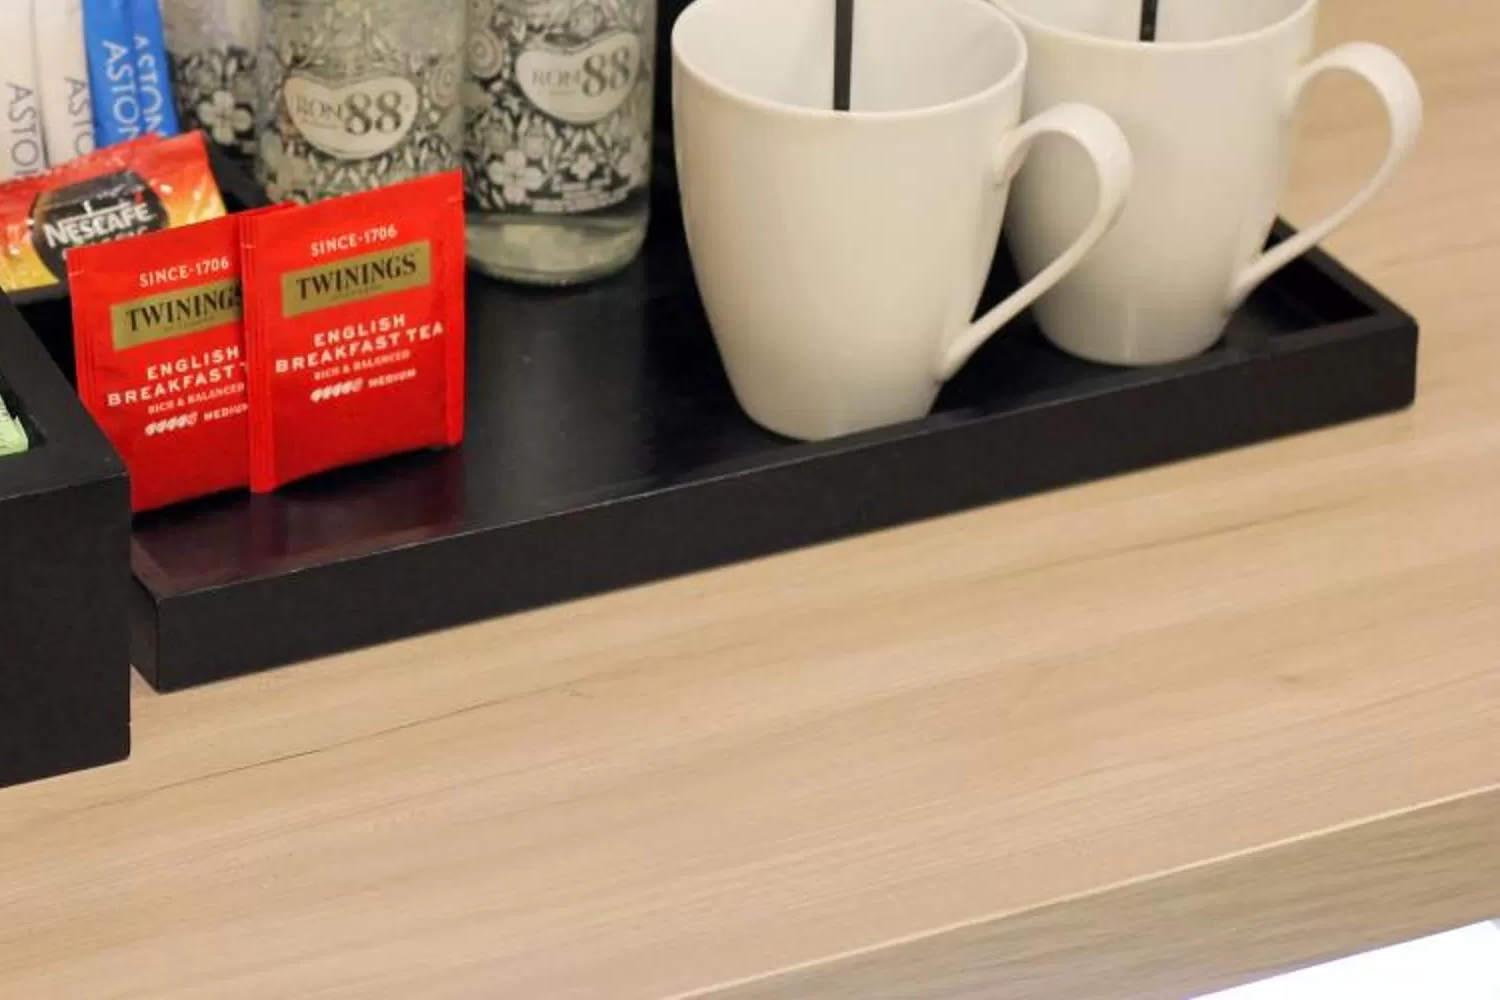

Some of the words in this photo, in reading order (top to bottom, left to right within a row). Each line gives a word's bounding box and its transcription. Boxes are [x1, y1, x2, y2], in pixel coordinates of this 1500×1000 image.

[582, 46, 631, 97] 88
[343, 90, 403, 136] 88
[296, 252, 417, 301] TWININGS
[274, 331, 401, 373] BREAKFAST
[405, 320, 444, 343] TEA
[313, 312, 406, 348] ENGLISH
[107, 364, 236, 407] BREAKFAST
[146, 345, 240, 381] ENGLISH
